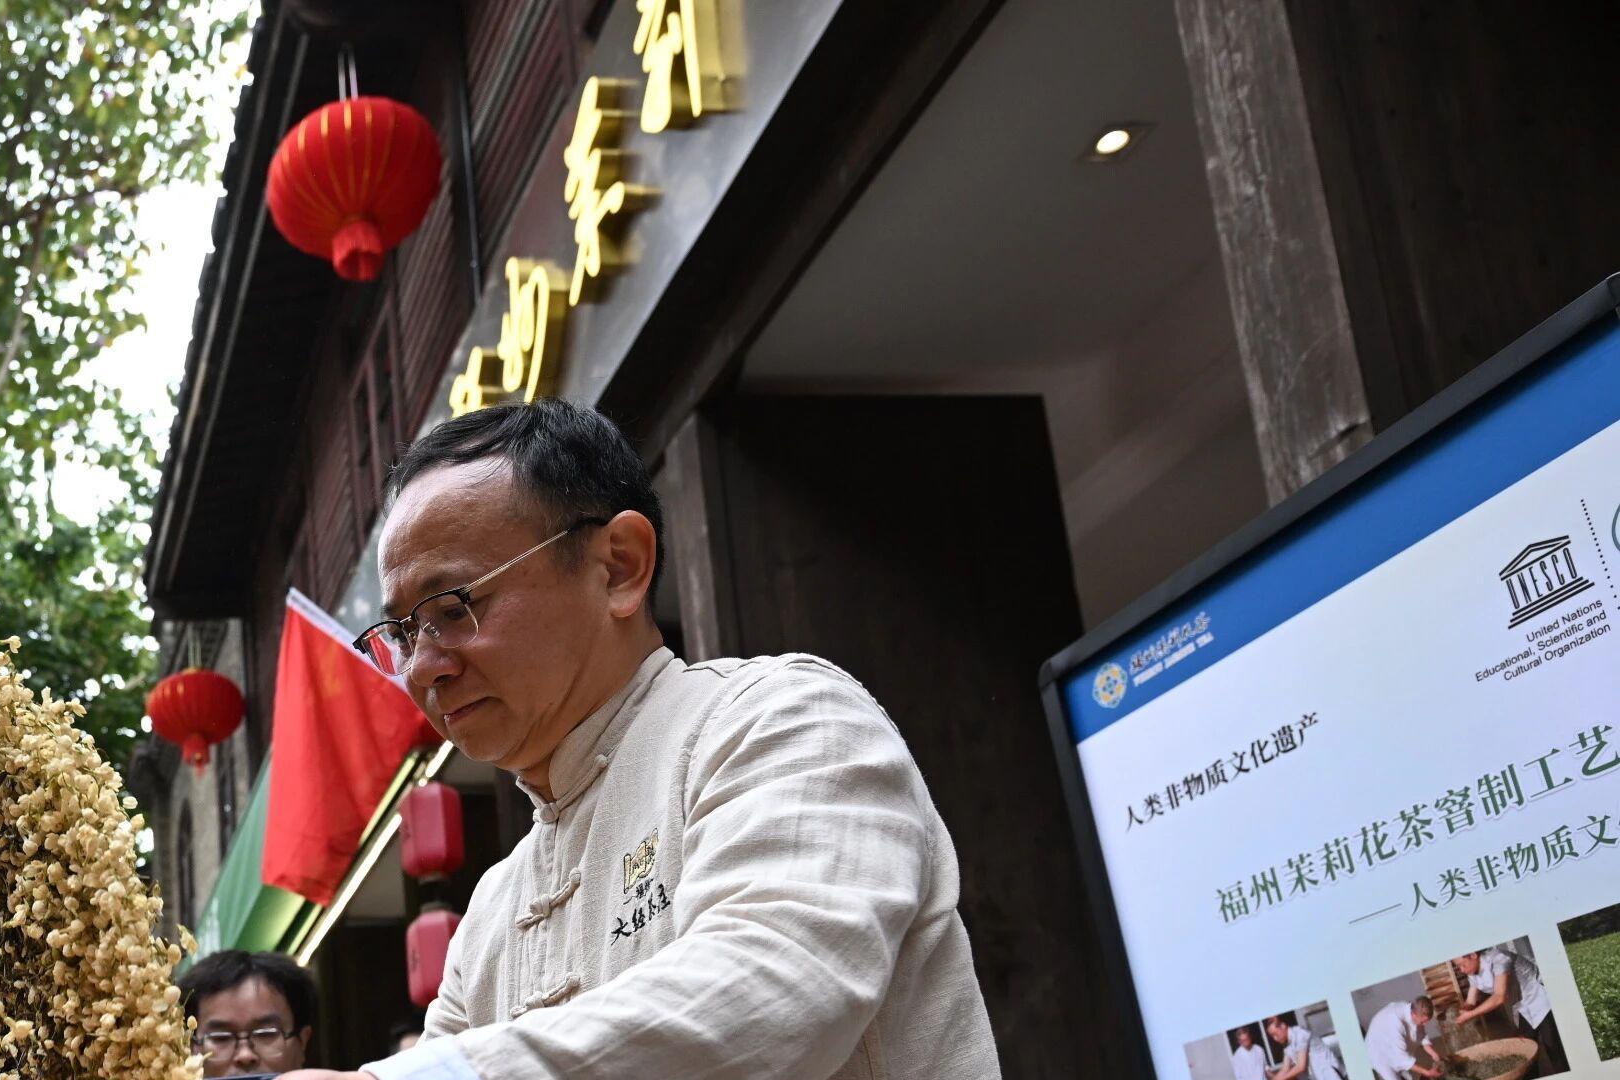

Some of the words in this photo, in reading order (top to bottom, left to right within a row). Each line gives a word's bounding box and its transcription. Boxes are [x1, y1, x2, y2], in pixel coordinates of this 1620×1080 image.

[1506, 547, 1577, 609] UNESCO
[1475, 647, 1535, 682] Educational,
[1537, 623, 1584, 651] Scientific
[1586, 610, 1607, 627] and
[1503, 657, 1542, 681] Cultural
[1544, 624, 1611, 661] Organization
[1526, 620, 1560, 642] United
[1562, 600, 1603, 624] Nations
[1125, 712, 1319, 832] 人类非物质文化遗产
[1216, 725, 1620, 924] 福州茉莉花茶窨制工艺
